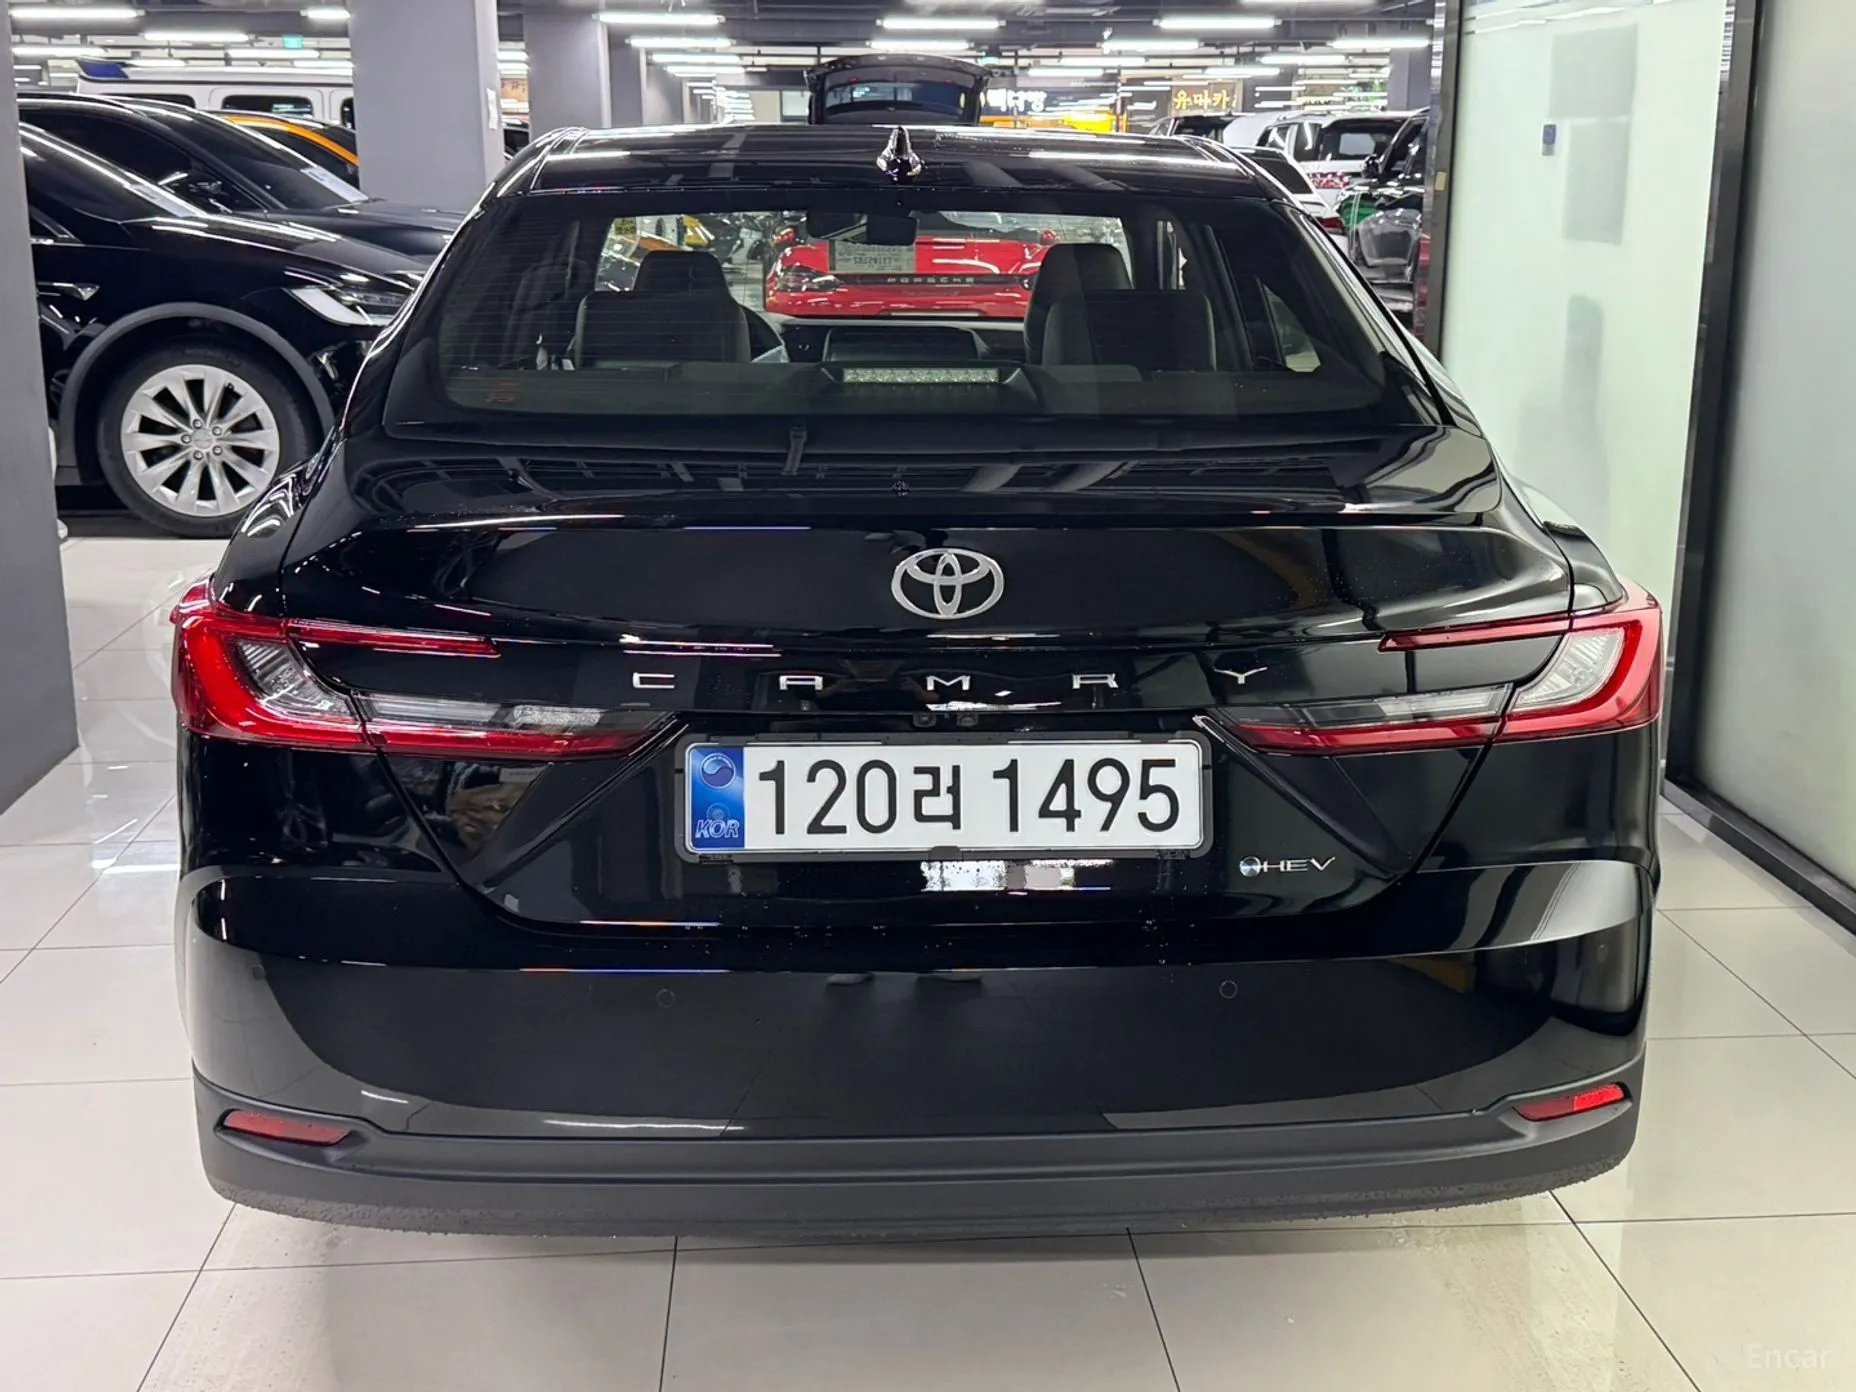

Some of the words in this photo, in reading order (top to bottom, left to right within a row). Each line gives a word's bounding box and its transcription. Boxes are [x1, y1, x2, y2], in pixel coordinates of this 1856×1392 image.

[632, 666, 1268, 691] CAMRY
[759, 758, 962, 835] 120러
[993, 757, 1180, 833] 1495
[694, 819, 740, 839] KOR
[1262, 856, 1336, 873] HEV
